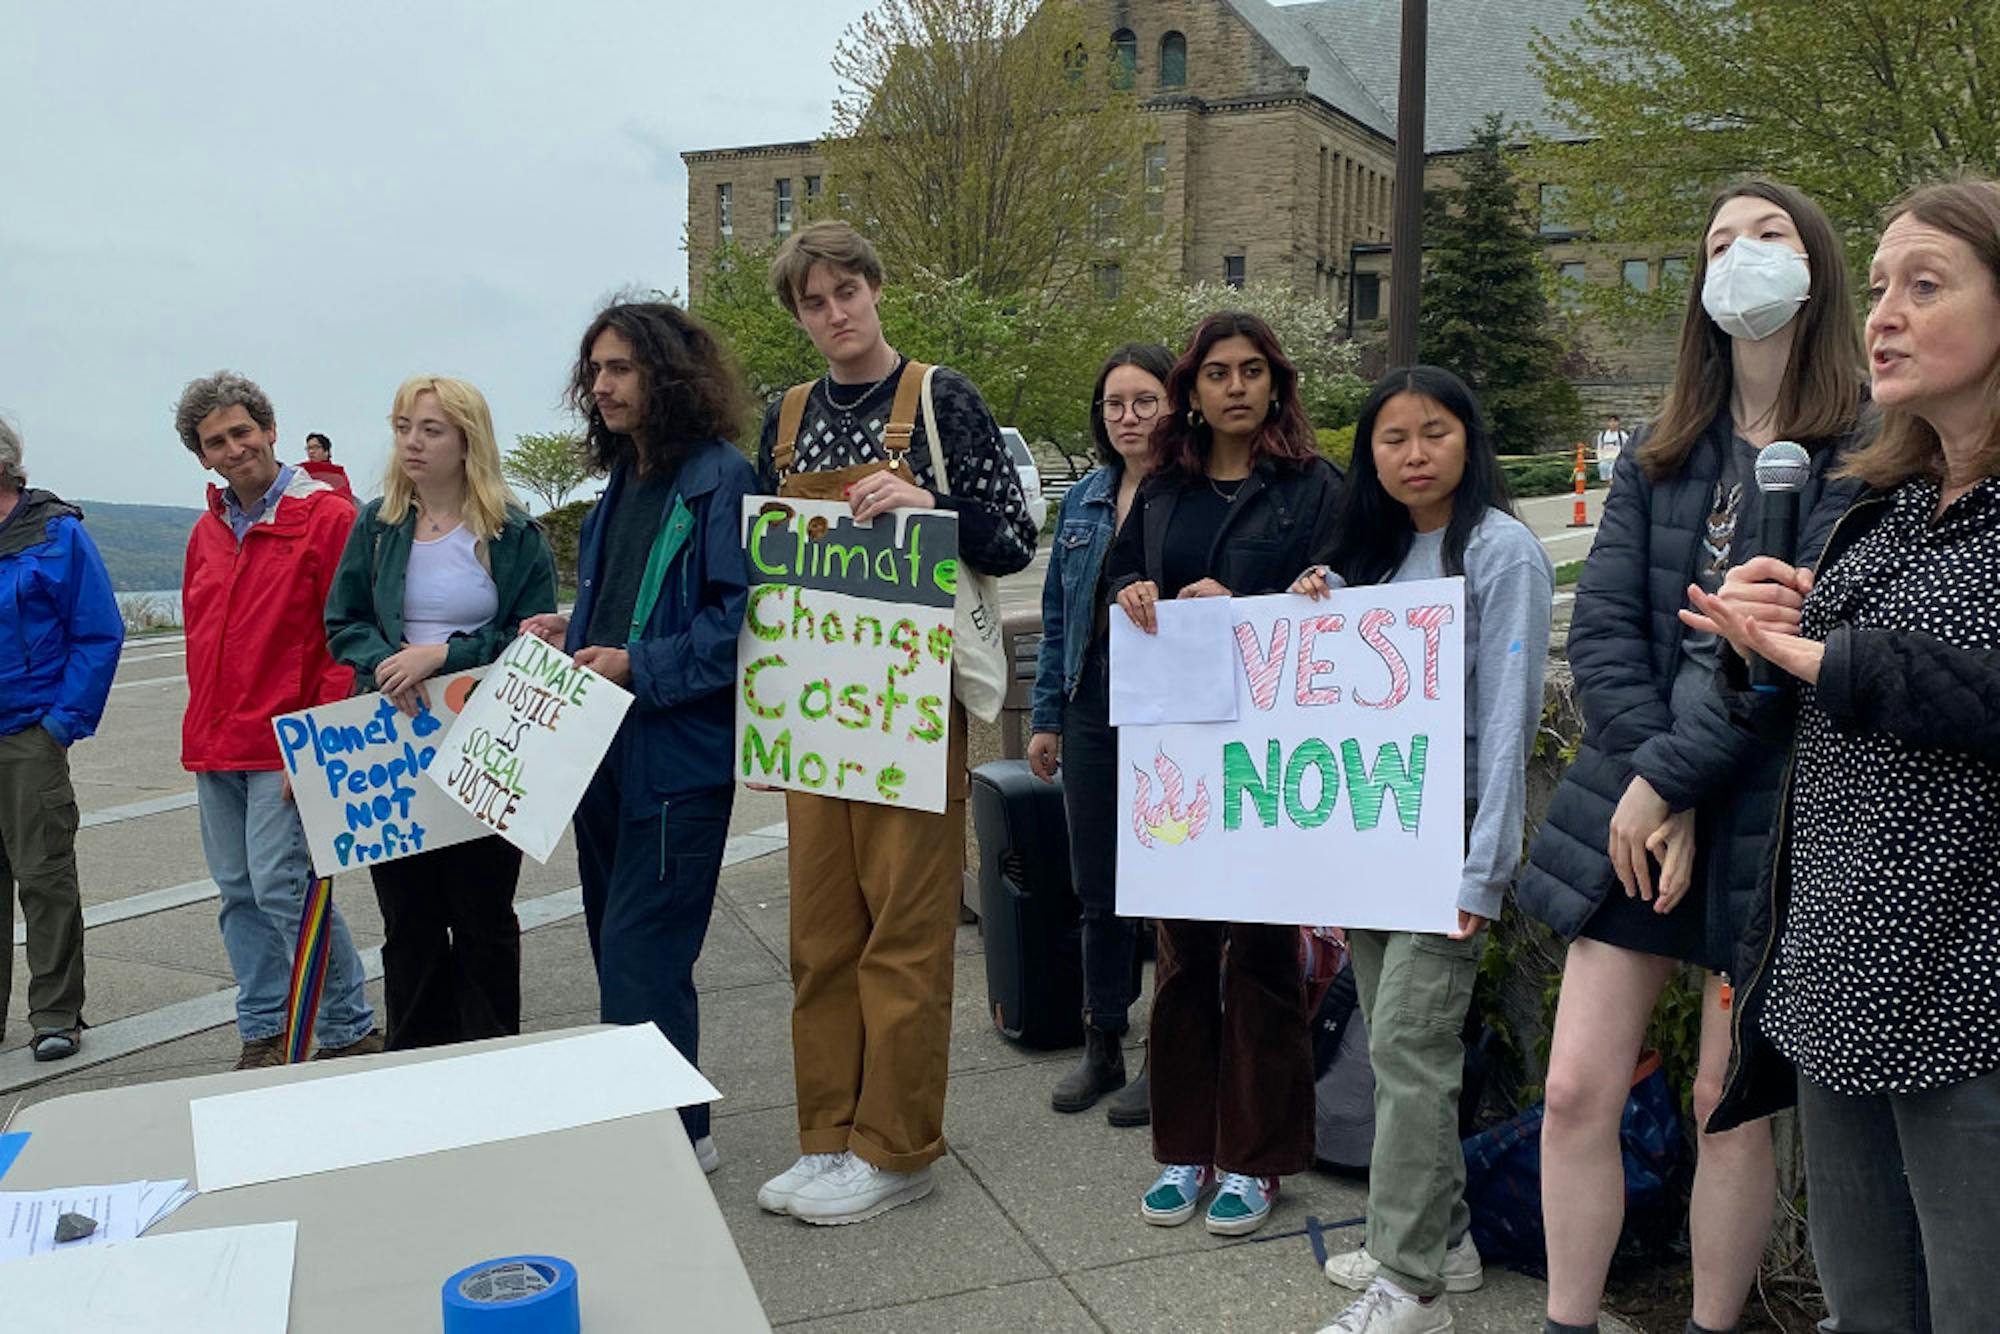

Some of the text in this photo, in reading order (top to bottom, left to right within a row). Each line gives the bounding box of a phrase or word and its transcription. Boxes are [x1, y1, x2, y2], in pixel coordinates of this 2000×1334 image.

[751, 510, 958, 594] Climate
[747, 583, 954, 675] Change
[1232, 604, 1454, 711] VEST
[276, 698, 399, 775] Planet
[495, 671, 568, 732] JUSTICE
[495, 714, 531, 752] IS
[743, 655, 945, 744] Costs
[447, 755, 521, 831] JUSTICE
[462, 727, 528, 796] SOCIAL
[742, 723, 907, 800] More
[1223, 734, 1429, 837] NOW
[334, 821, 426, 866] Profit
[346, 786, 416, 833] NOT
